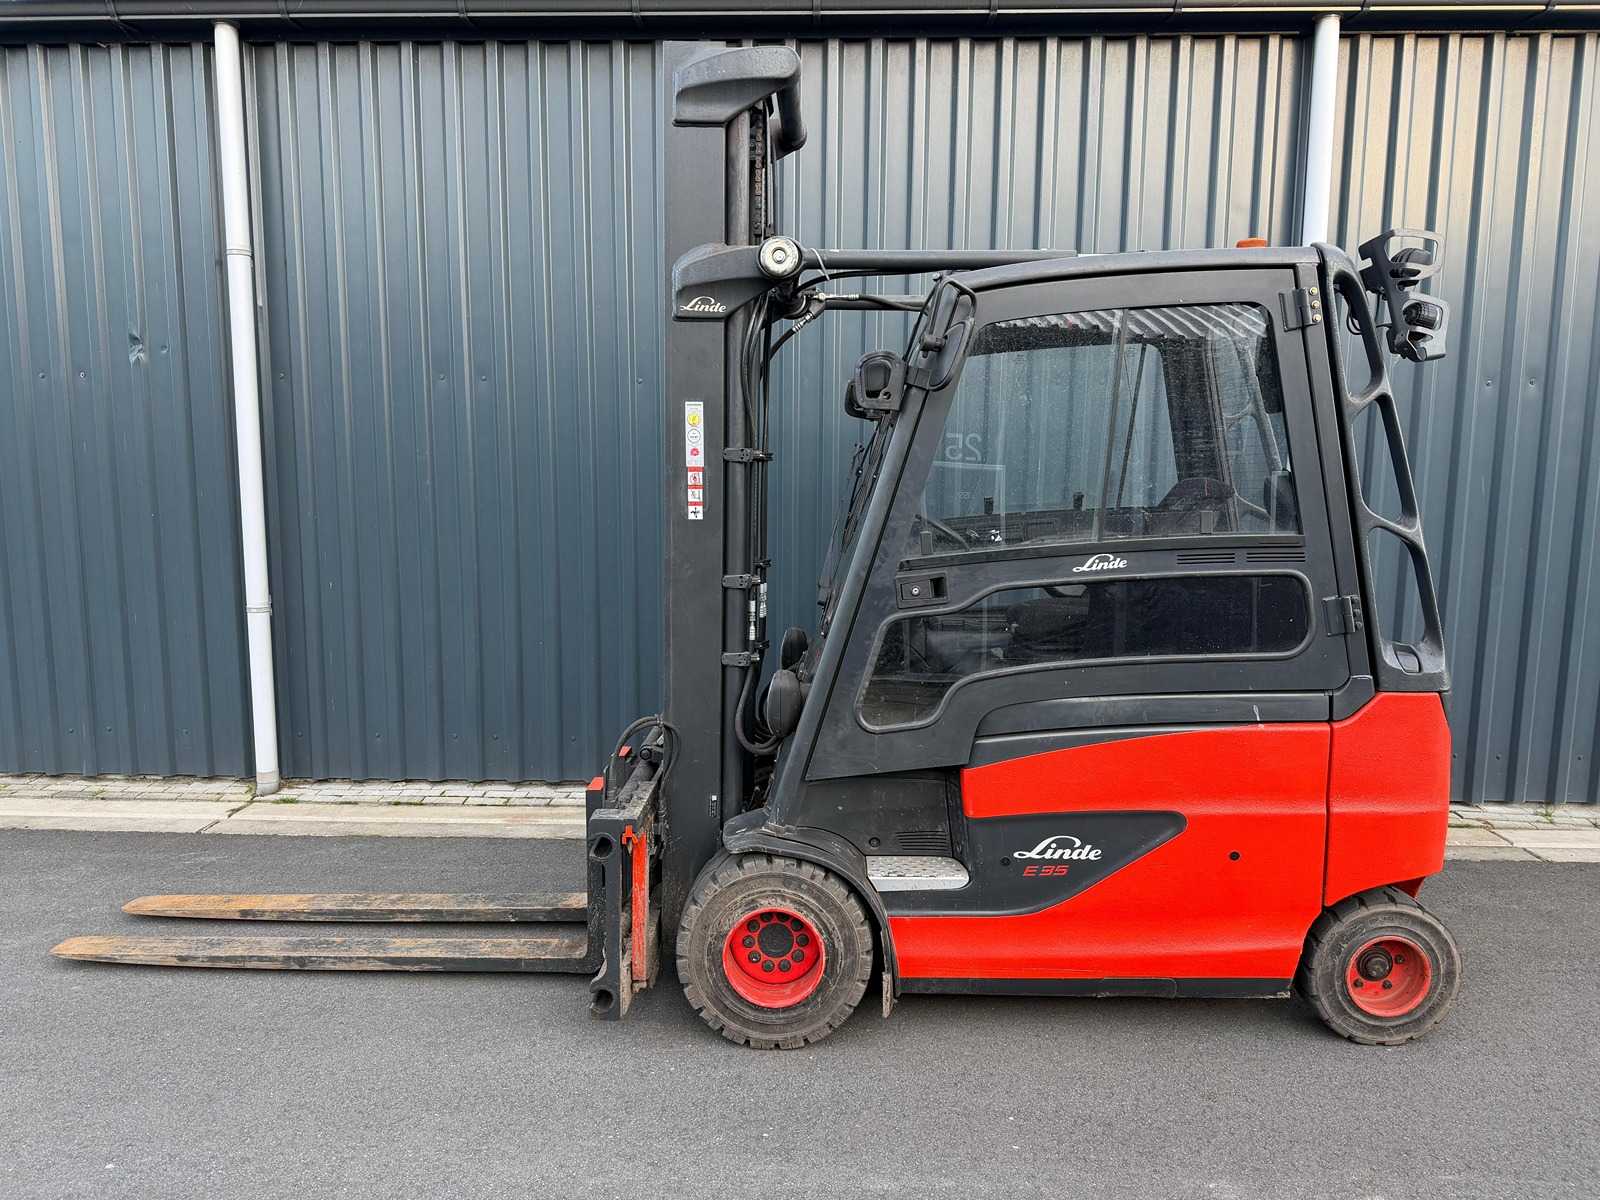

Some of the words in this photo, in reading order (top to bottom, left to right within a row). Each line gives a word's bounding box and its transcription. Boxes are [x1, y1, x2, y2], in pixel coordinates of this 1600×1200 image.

[679, 296, 727, 312] Linde
[1072, 553, 1128, 573] Linde
[1013, 835, 1102, 861] Linde
